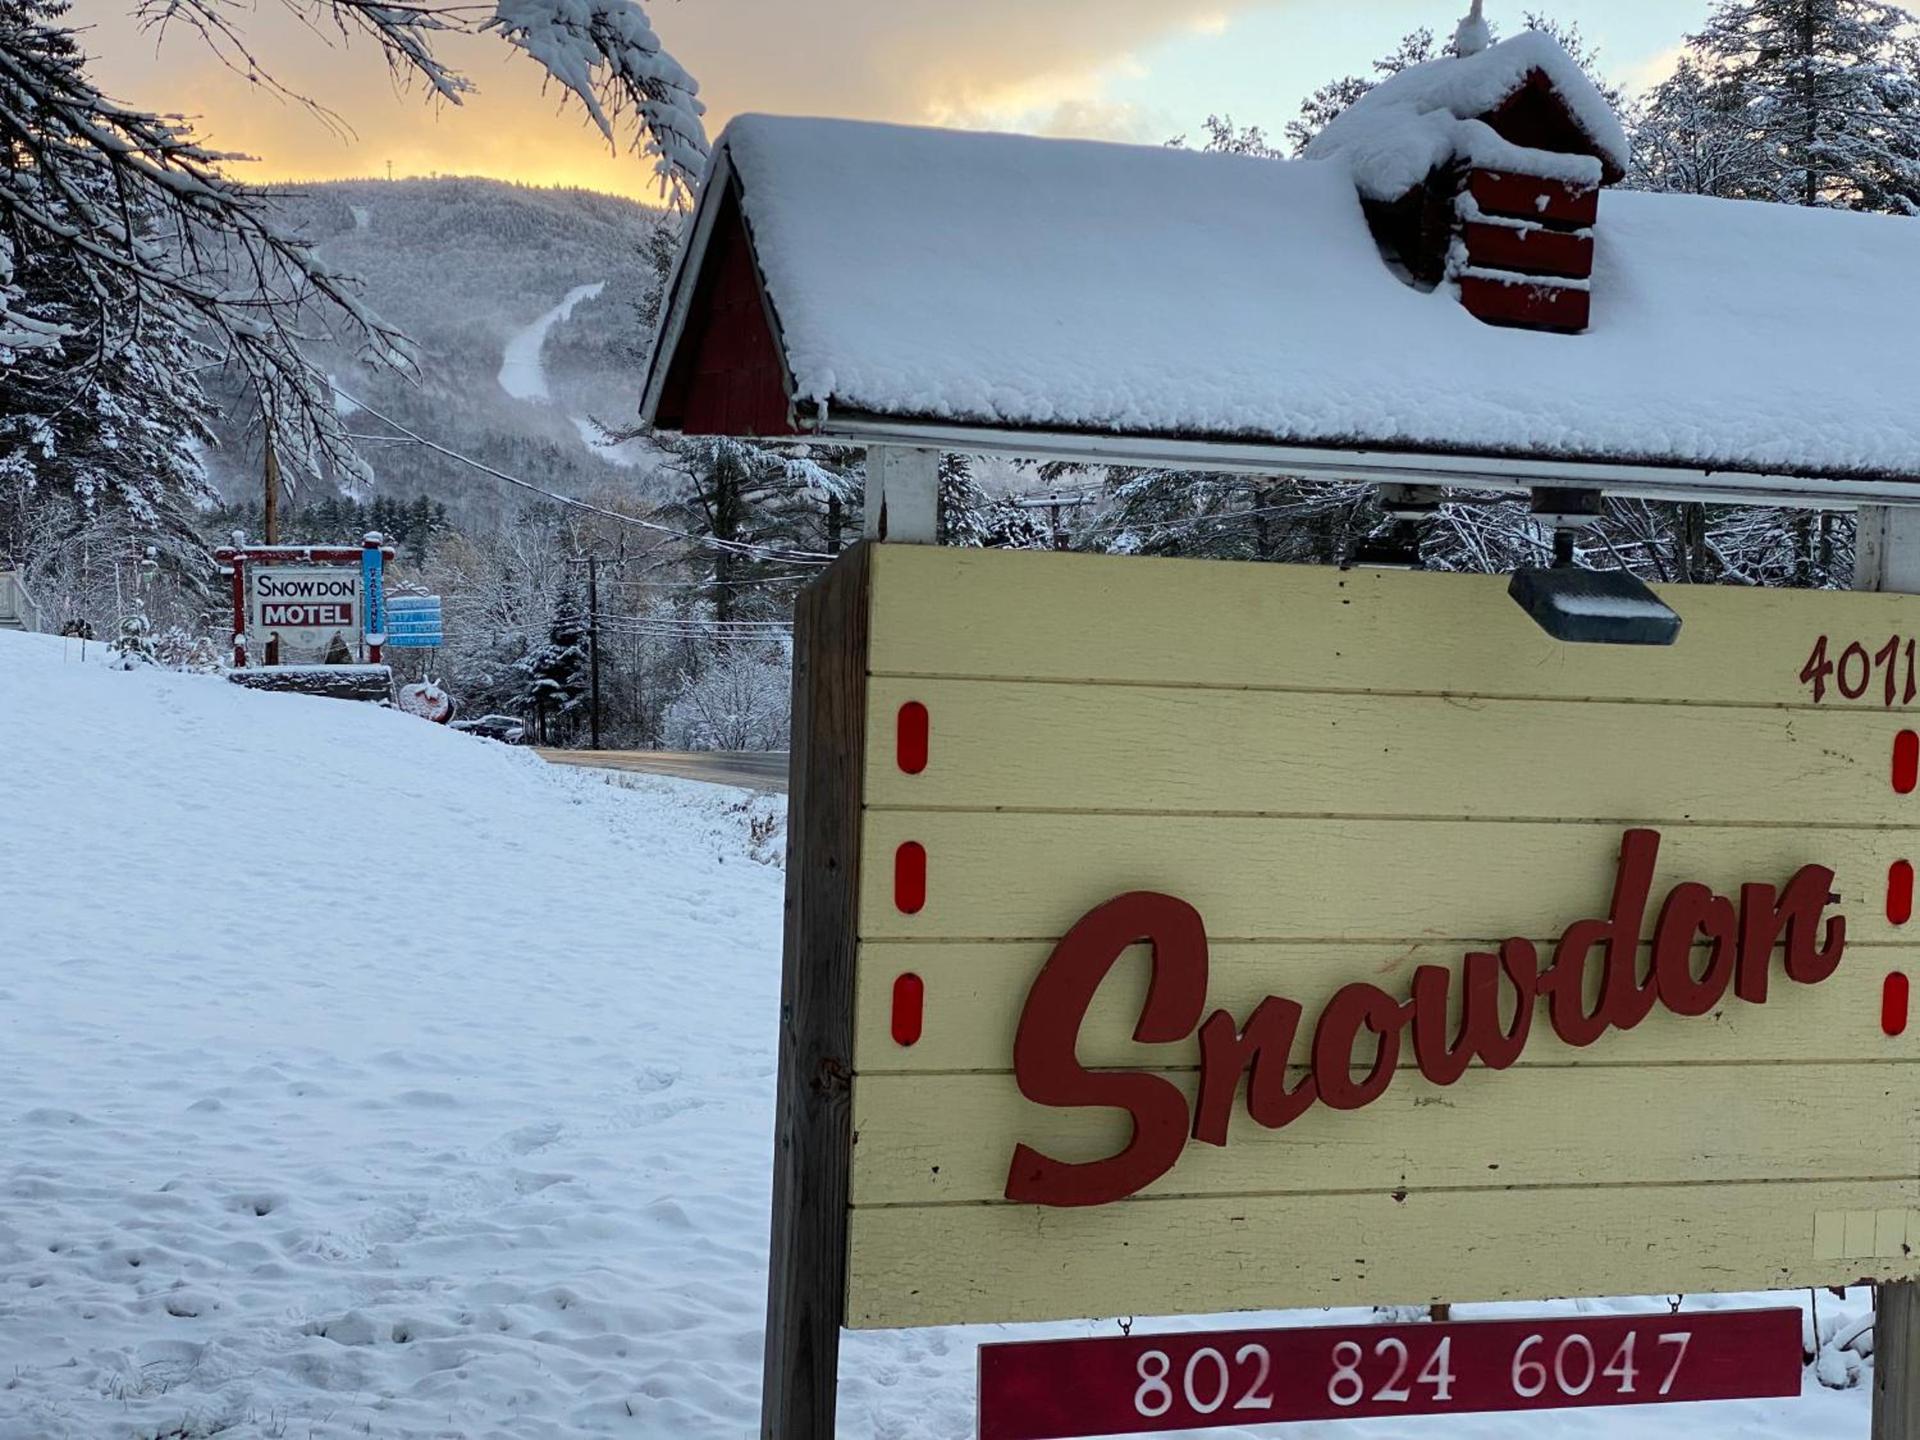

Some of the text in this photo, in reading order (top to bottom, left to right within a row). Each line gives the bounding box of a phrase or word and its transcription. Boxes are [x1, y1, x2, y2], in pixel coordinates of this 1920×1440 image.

[257, 575, 355, 597] SNOWDON
[264, 604, 350, 625] MOTEL
[1799, 633, 1917, 707] 4011
[1004, 828, 1847, 1207] Snowdon
[1133, 1330, 1692, 1417] 802 824 6047
